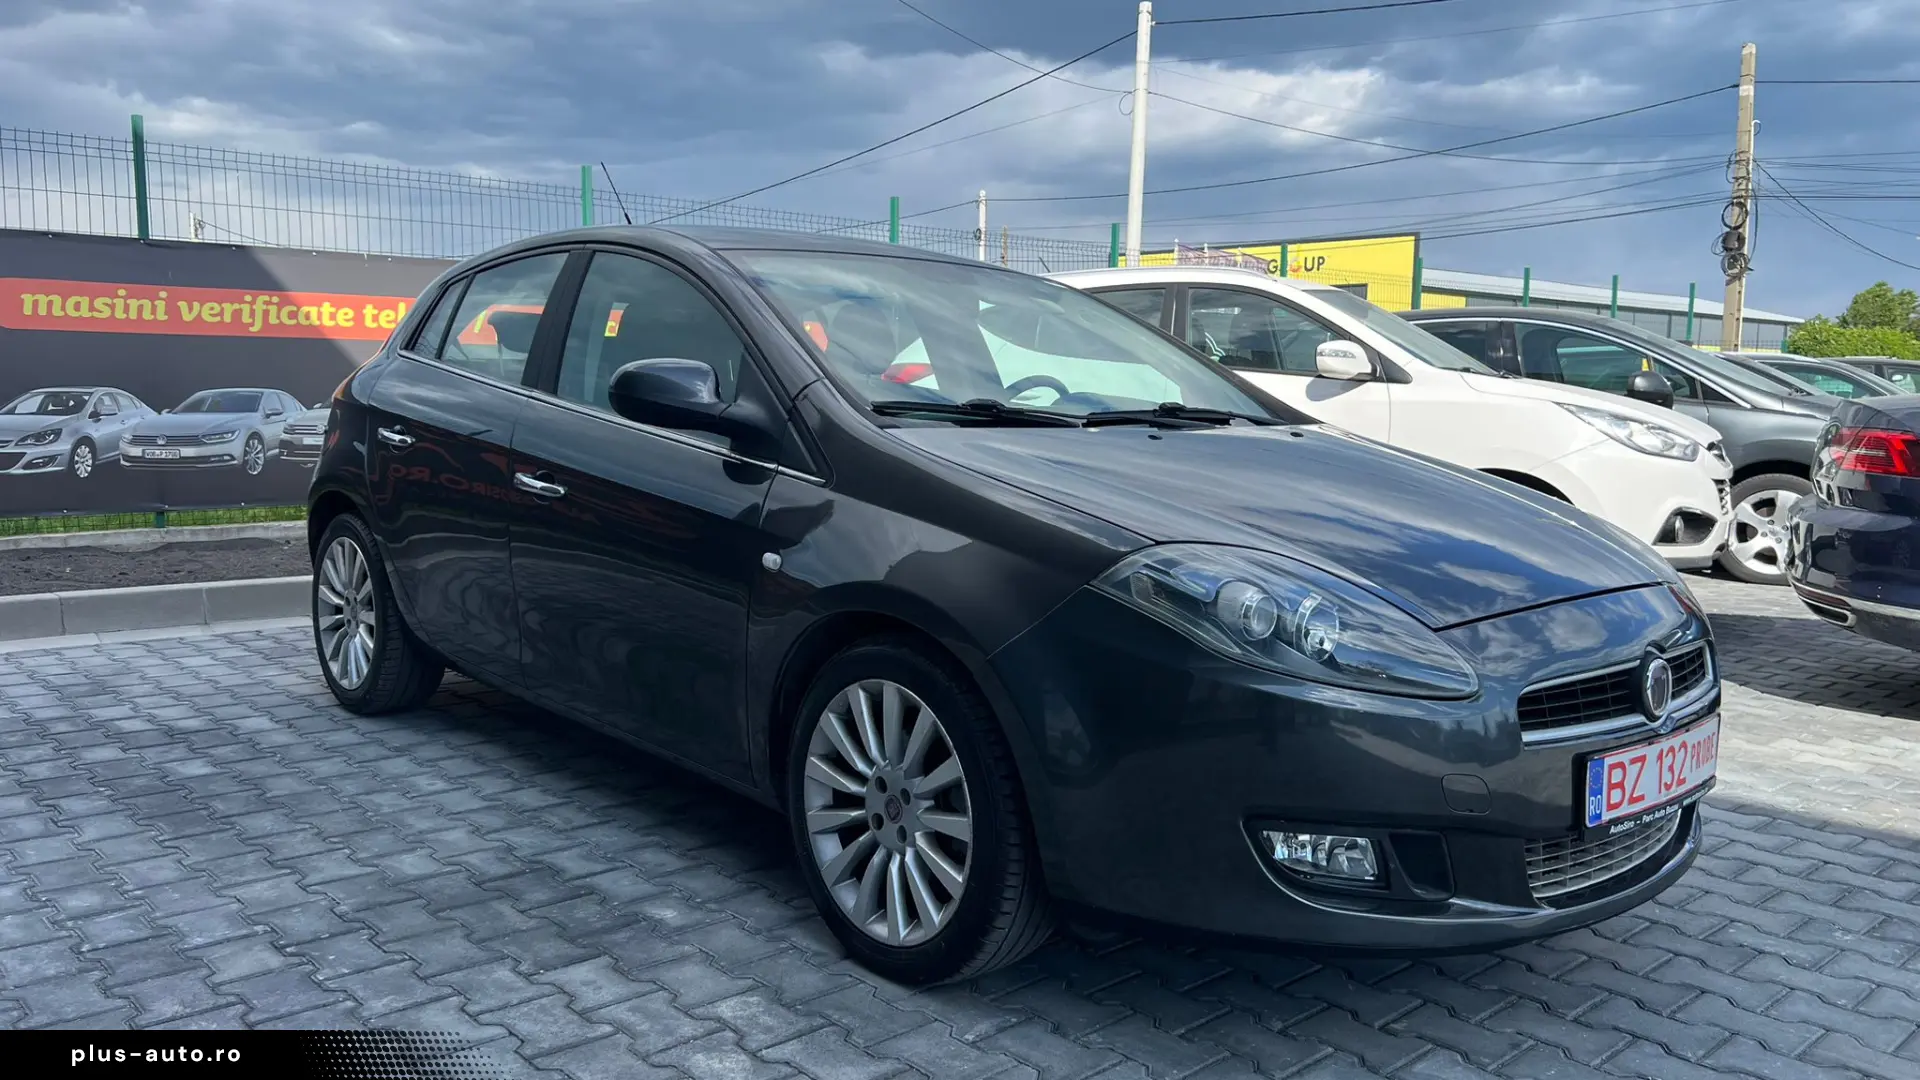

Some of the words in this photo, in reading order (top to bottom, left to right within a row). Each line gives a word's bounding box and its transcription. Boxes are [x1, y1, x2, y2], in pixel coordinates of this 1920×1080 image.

[20, 288, 169, 321] masini
[177, 294, 354, 332] verificate
[1606, 753, 1648, 813] BZ
[1656, 740, 1689, 795] 132
[1589, 795, 1602, 817] RO
